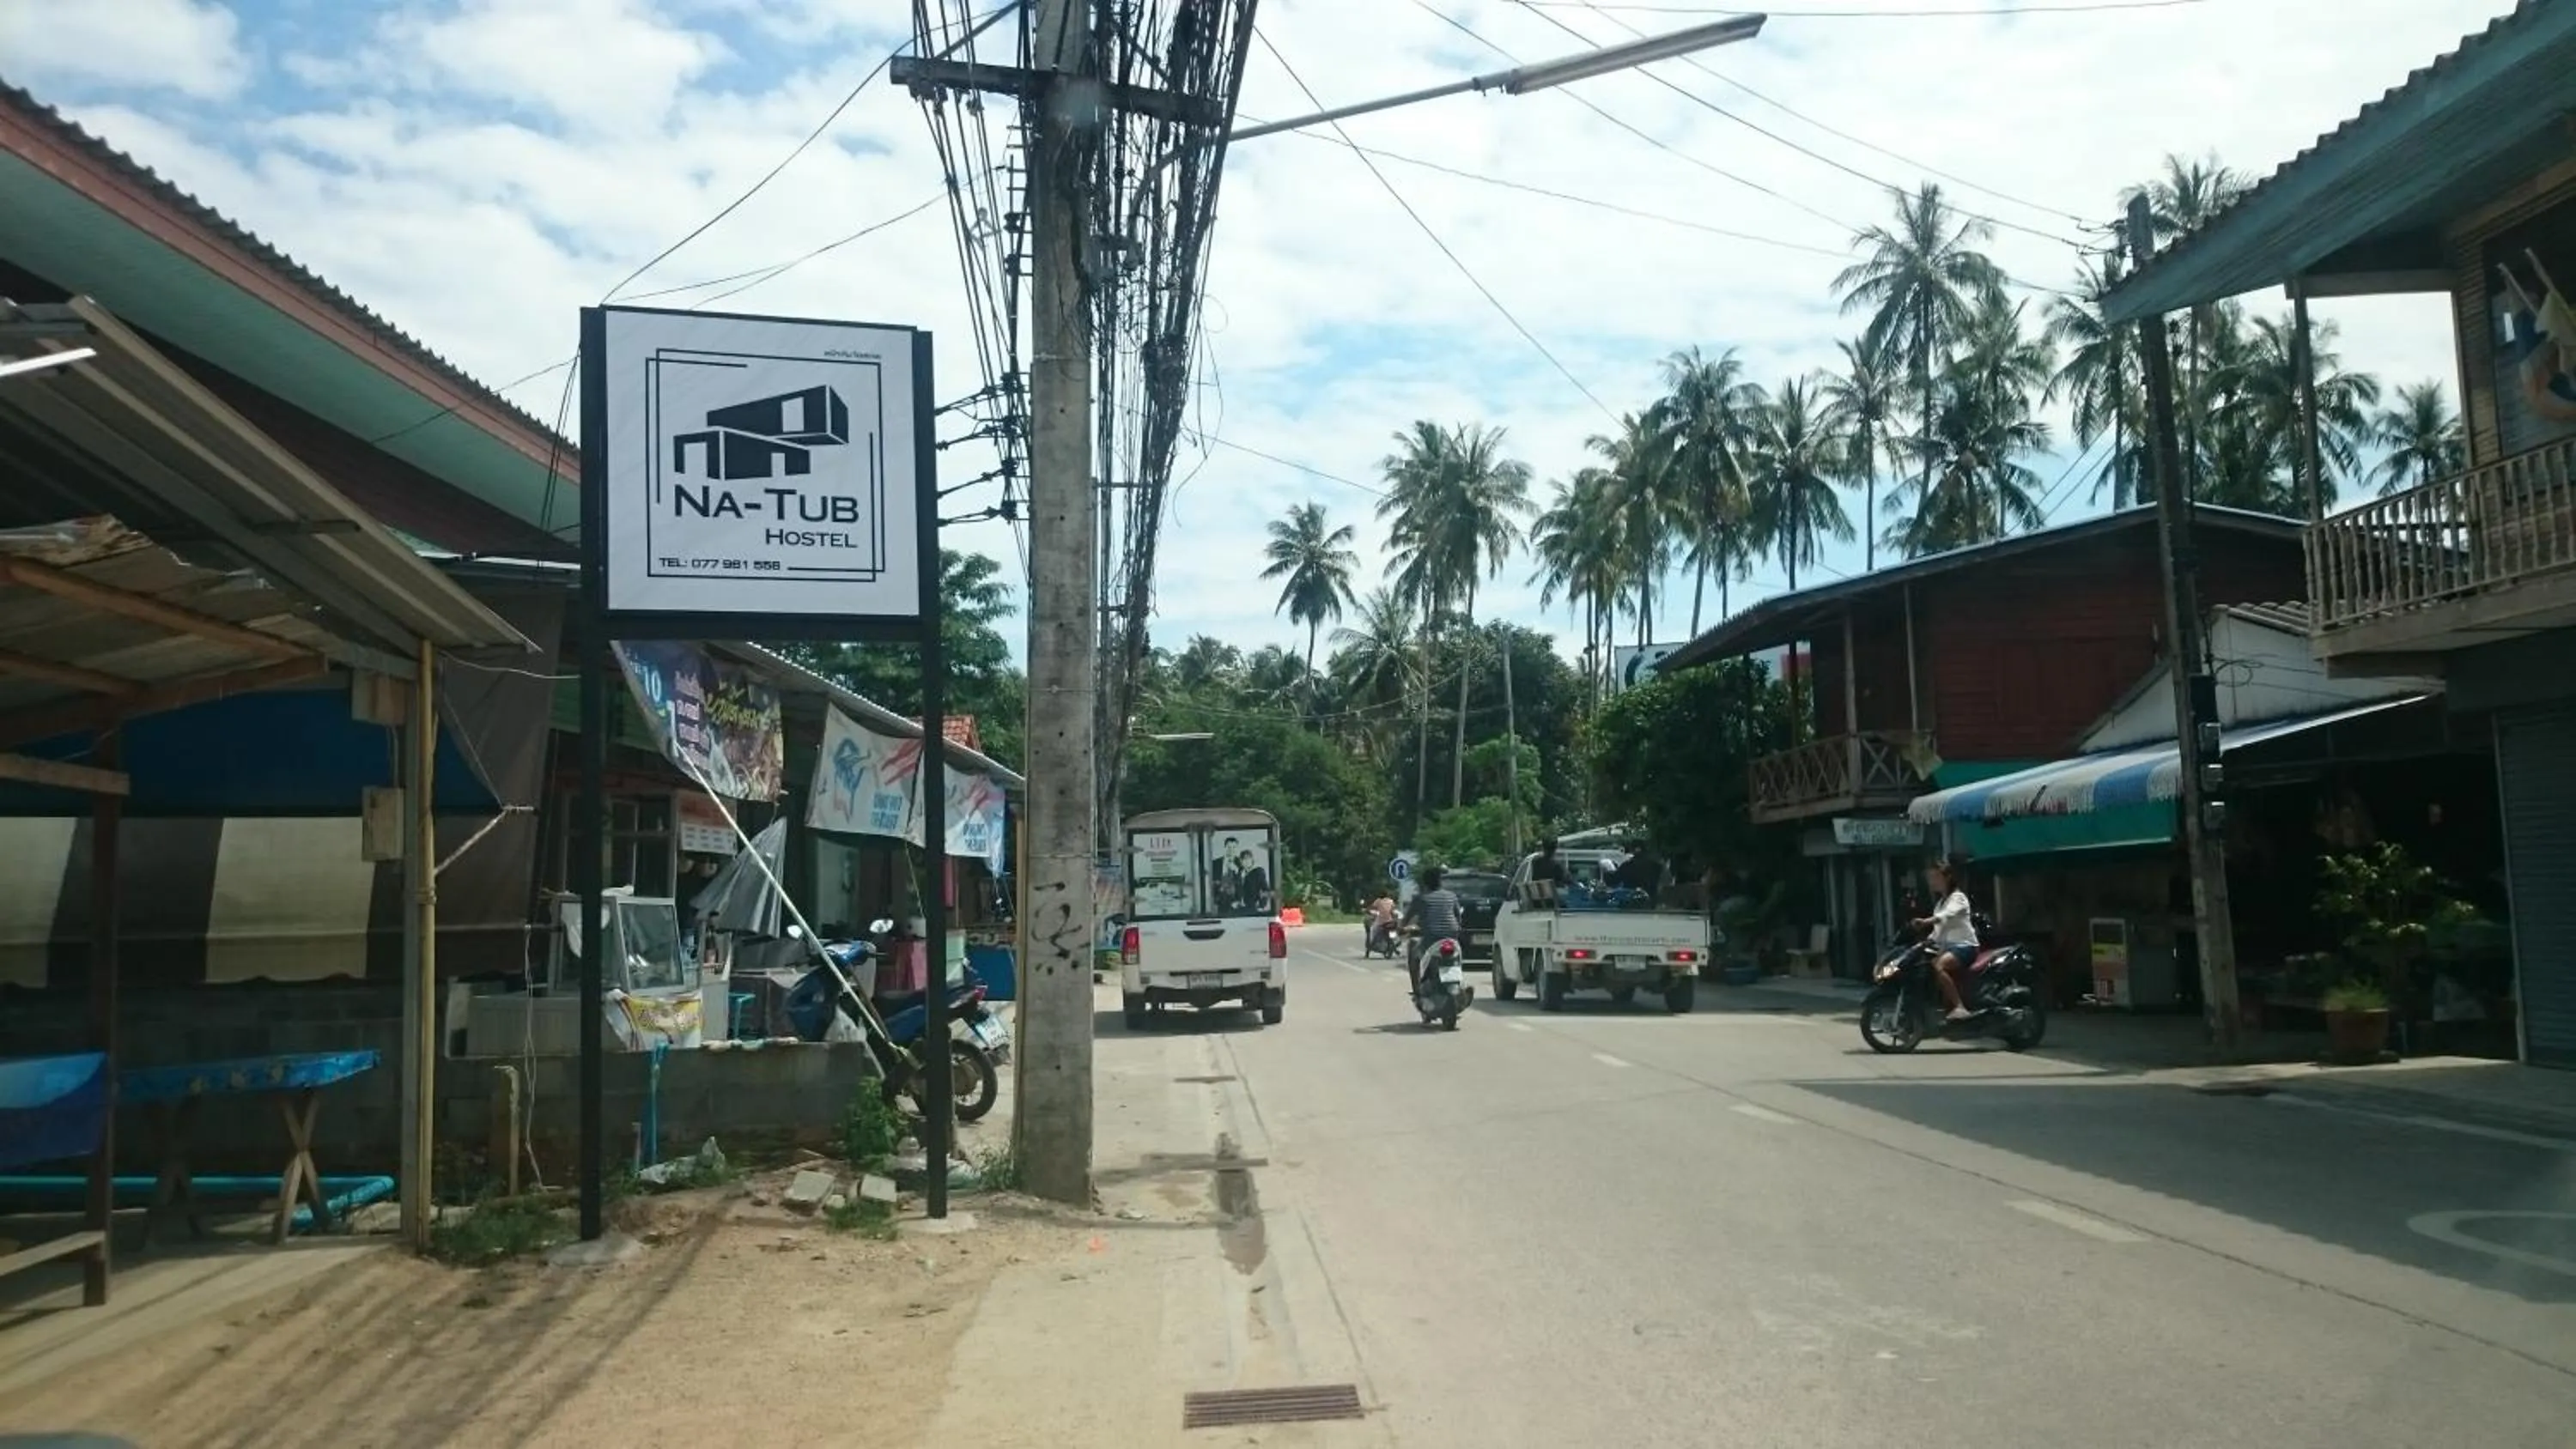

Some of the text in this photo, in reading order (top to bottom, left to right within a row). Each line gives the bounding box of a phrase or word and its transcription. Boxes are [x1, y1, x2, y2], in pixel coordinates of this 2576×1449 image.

[674, 484, 860, 524] NA-TUB
[765, 529, 858, 548] HOSTEL
[659, 558, 688, 567] TEL:
[692, 559, 719, 569] 077
[723, 560, 747, 570] 981
